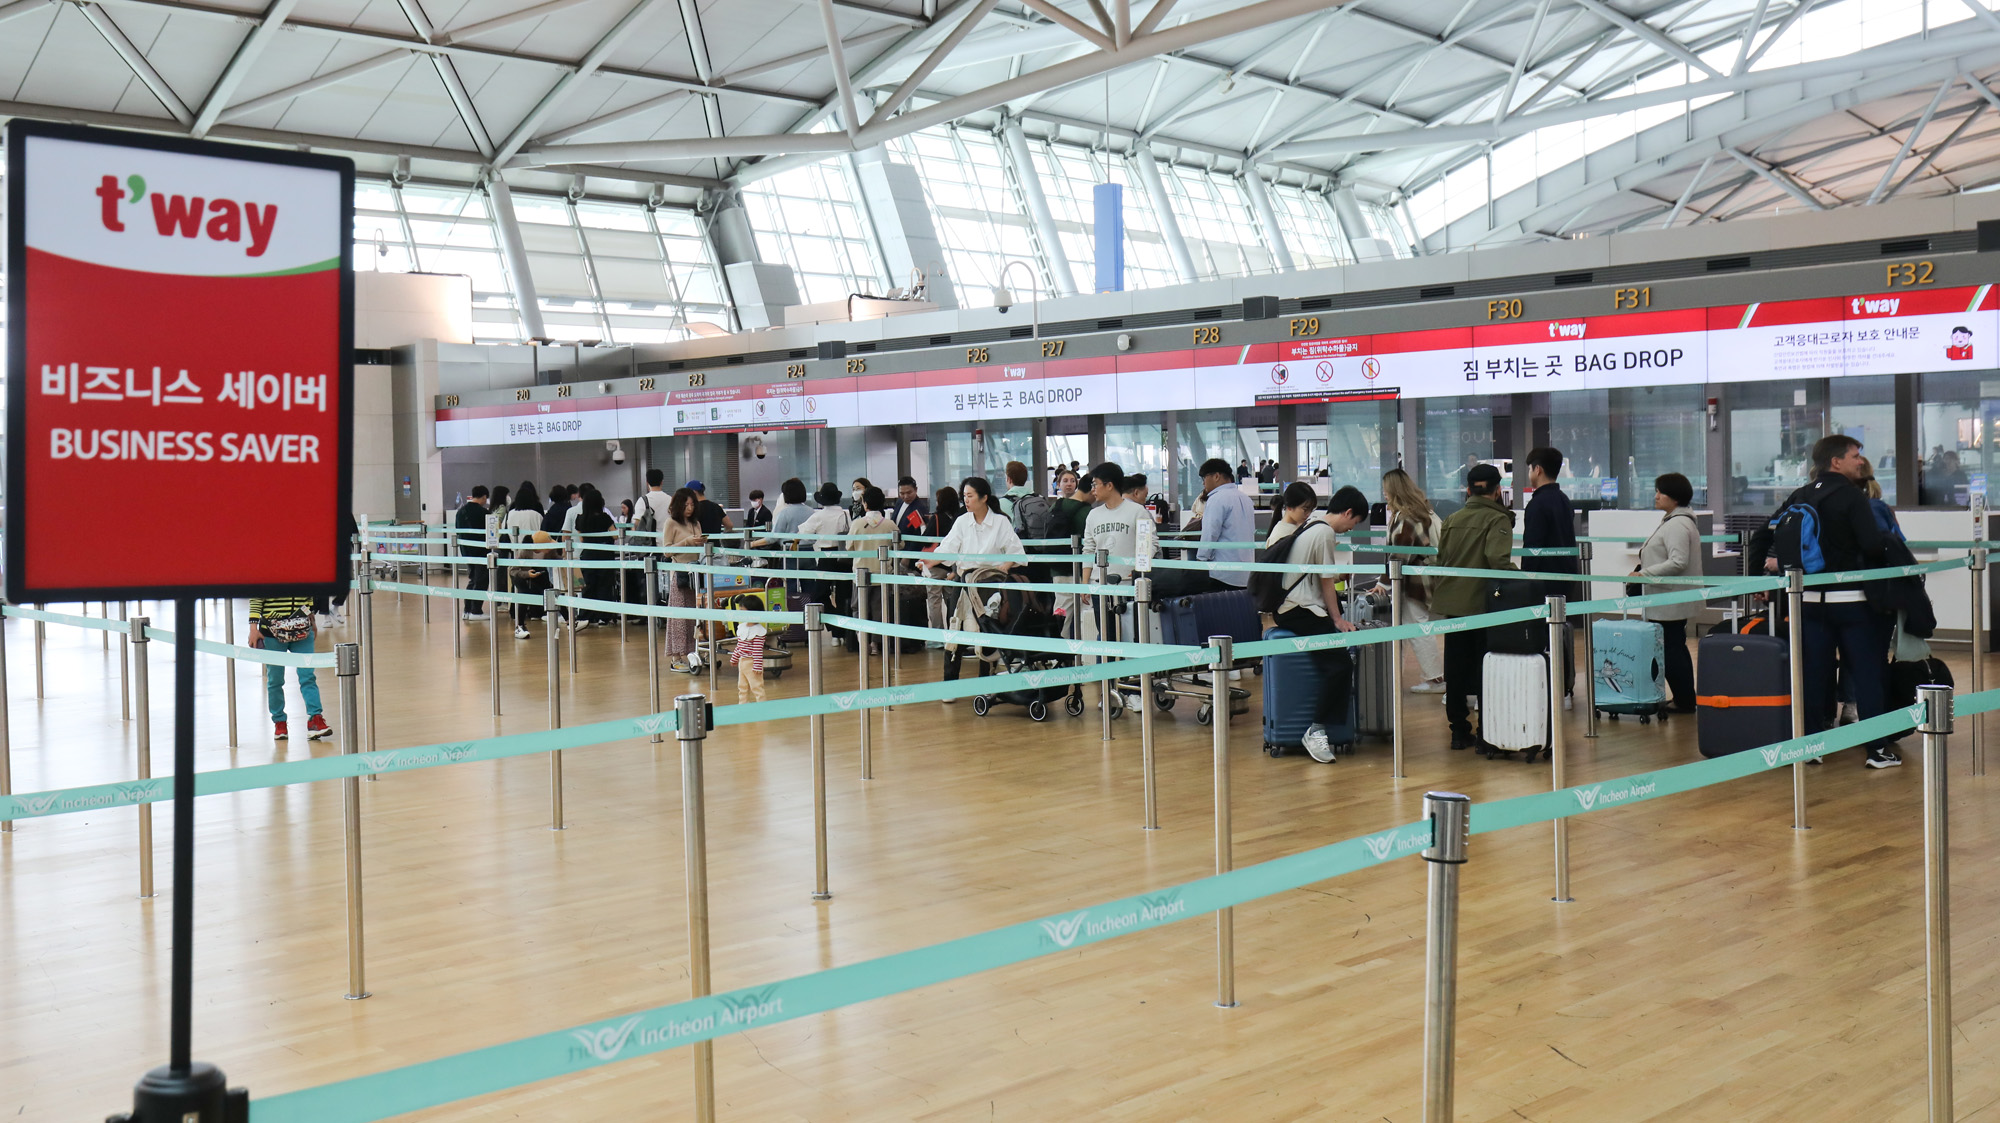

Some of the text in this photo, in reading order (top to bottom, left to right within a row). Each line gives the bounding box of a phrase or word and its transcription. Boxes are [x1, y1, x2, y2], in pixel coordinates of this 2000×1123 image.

[95, 173, 278, 257] t'way
[1886, 261, 1935, 287] F32
[1614, 287, 1653, 310] F31
[1851, 296, 1900, 318] t'way
[1487, 298, 1523, 321] F30
[1193, 326, 1221, 346] F28
[1290, 317, 1320, 338] F29
[1548, 320, 1587, 339] t'way
[1773, 326, 1921, 347] 고객응대근로자 보호 안내문
[966, 347, 990, 364] F26
[1041, 340, 1065, 358] F27
[787, 364, 805, 380] F24
[846, 358, 866, 374] F25
[1003, 364, 1026, 380] t'way
[1462, 347, 1684, 382] 짐 부치는 곳 BAG DROP
[40, 362, 328, 413] 비즈니스 세이버
[639, 377, 654, 391] F22
[688, 373, 704, 387] F23
[446, 395, 459, 407] F19
[516, 389, 529, 401] F20
[557, 385, 571, 397] F21
[953, 386, 1083, 411] 짐 부치는 곳 BAG DROP
[509, 420, 582, 436] 짐 부치는 곳 BAG DROP
[50, 428, 320, 464] BUSINESS SAVER
[1308, 637, 1347, 649] Incheon Airport
[1044, 669, 1094, 685] Incheon Airport
[857, 689, 915, 706] Incheon Airport
[397, 747, 478, 769] Incheon Airport
[1781, 741, 1826, 762] Incheon Airport
[60, 785, 163, 809] Incheon Airport
[1599, 781, 1656, 804] Incheon Airport
[1086, 898, 1185, 937] Incheon Airport
[639, 996, 784, 1047] Incheon Airport
